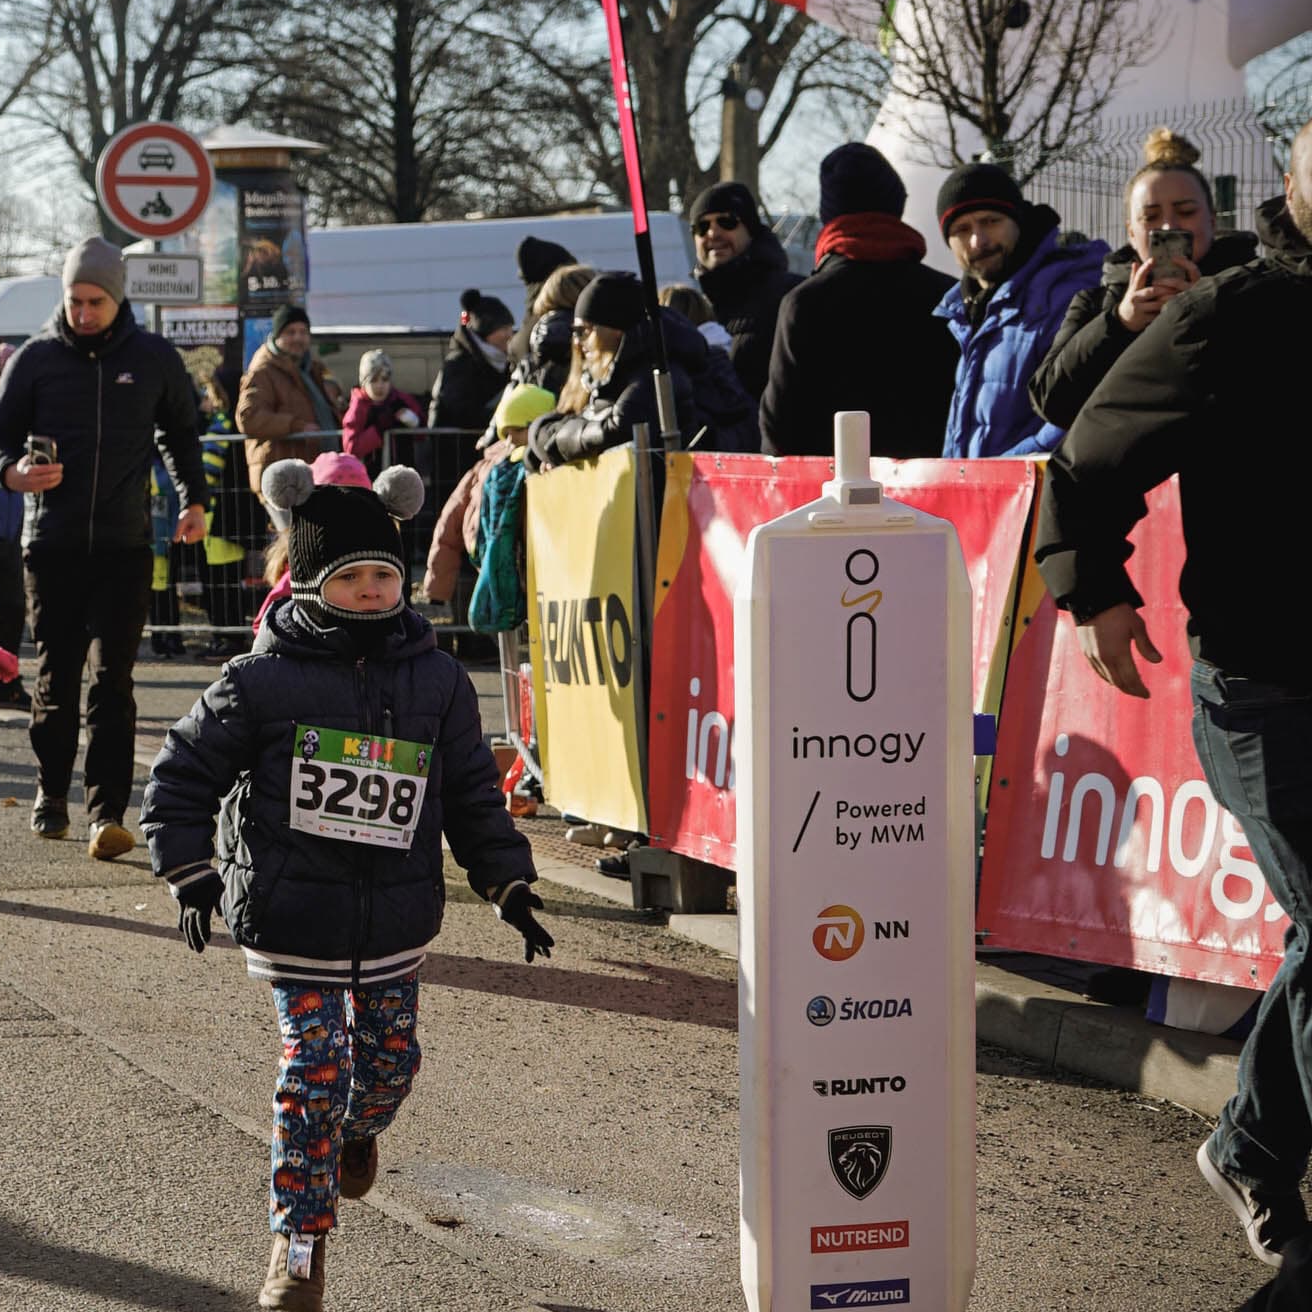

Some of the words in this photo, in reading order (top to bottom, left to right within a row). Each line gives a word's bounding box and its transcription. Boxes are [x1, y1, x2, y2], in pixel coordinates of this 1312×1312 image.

[792, 726, 926, 764] innogy
[295, 763, 417, 826] 3298
[836, 796, 927, 820] Powered
[836, 825, 862, 850] by
[871, 823, 925, 844] MVM
[1040, 733, 1288, 923] innog
[875, 920, 910, 940] NN
[839, 996, 913, 1021] ŠKODA
[831, 1075, 906, 1096] RUNTO
[834, 1131, 887, 1142] PEUGEOT
[816, 1226, 905, 1248] NUTREND
